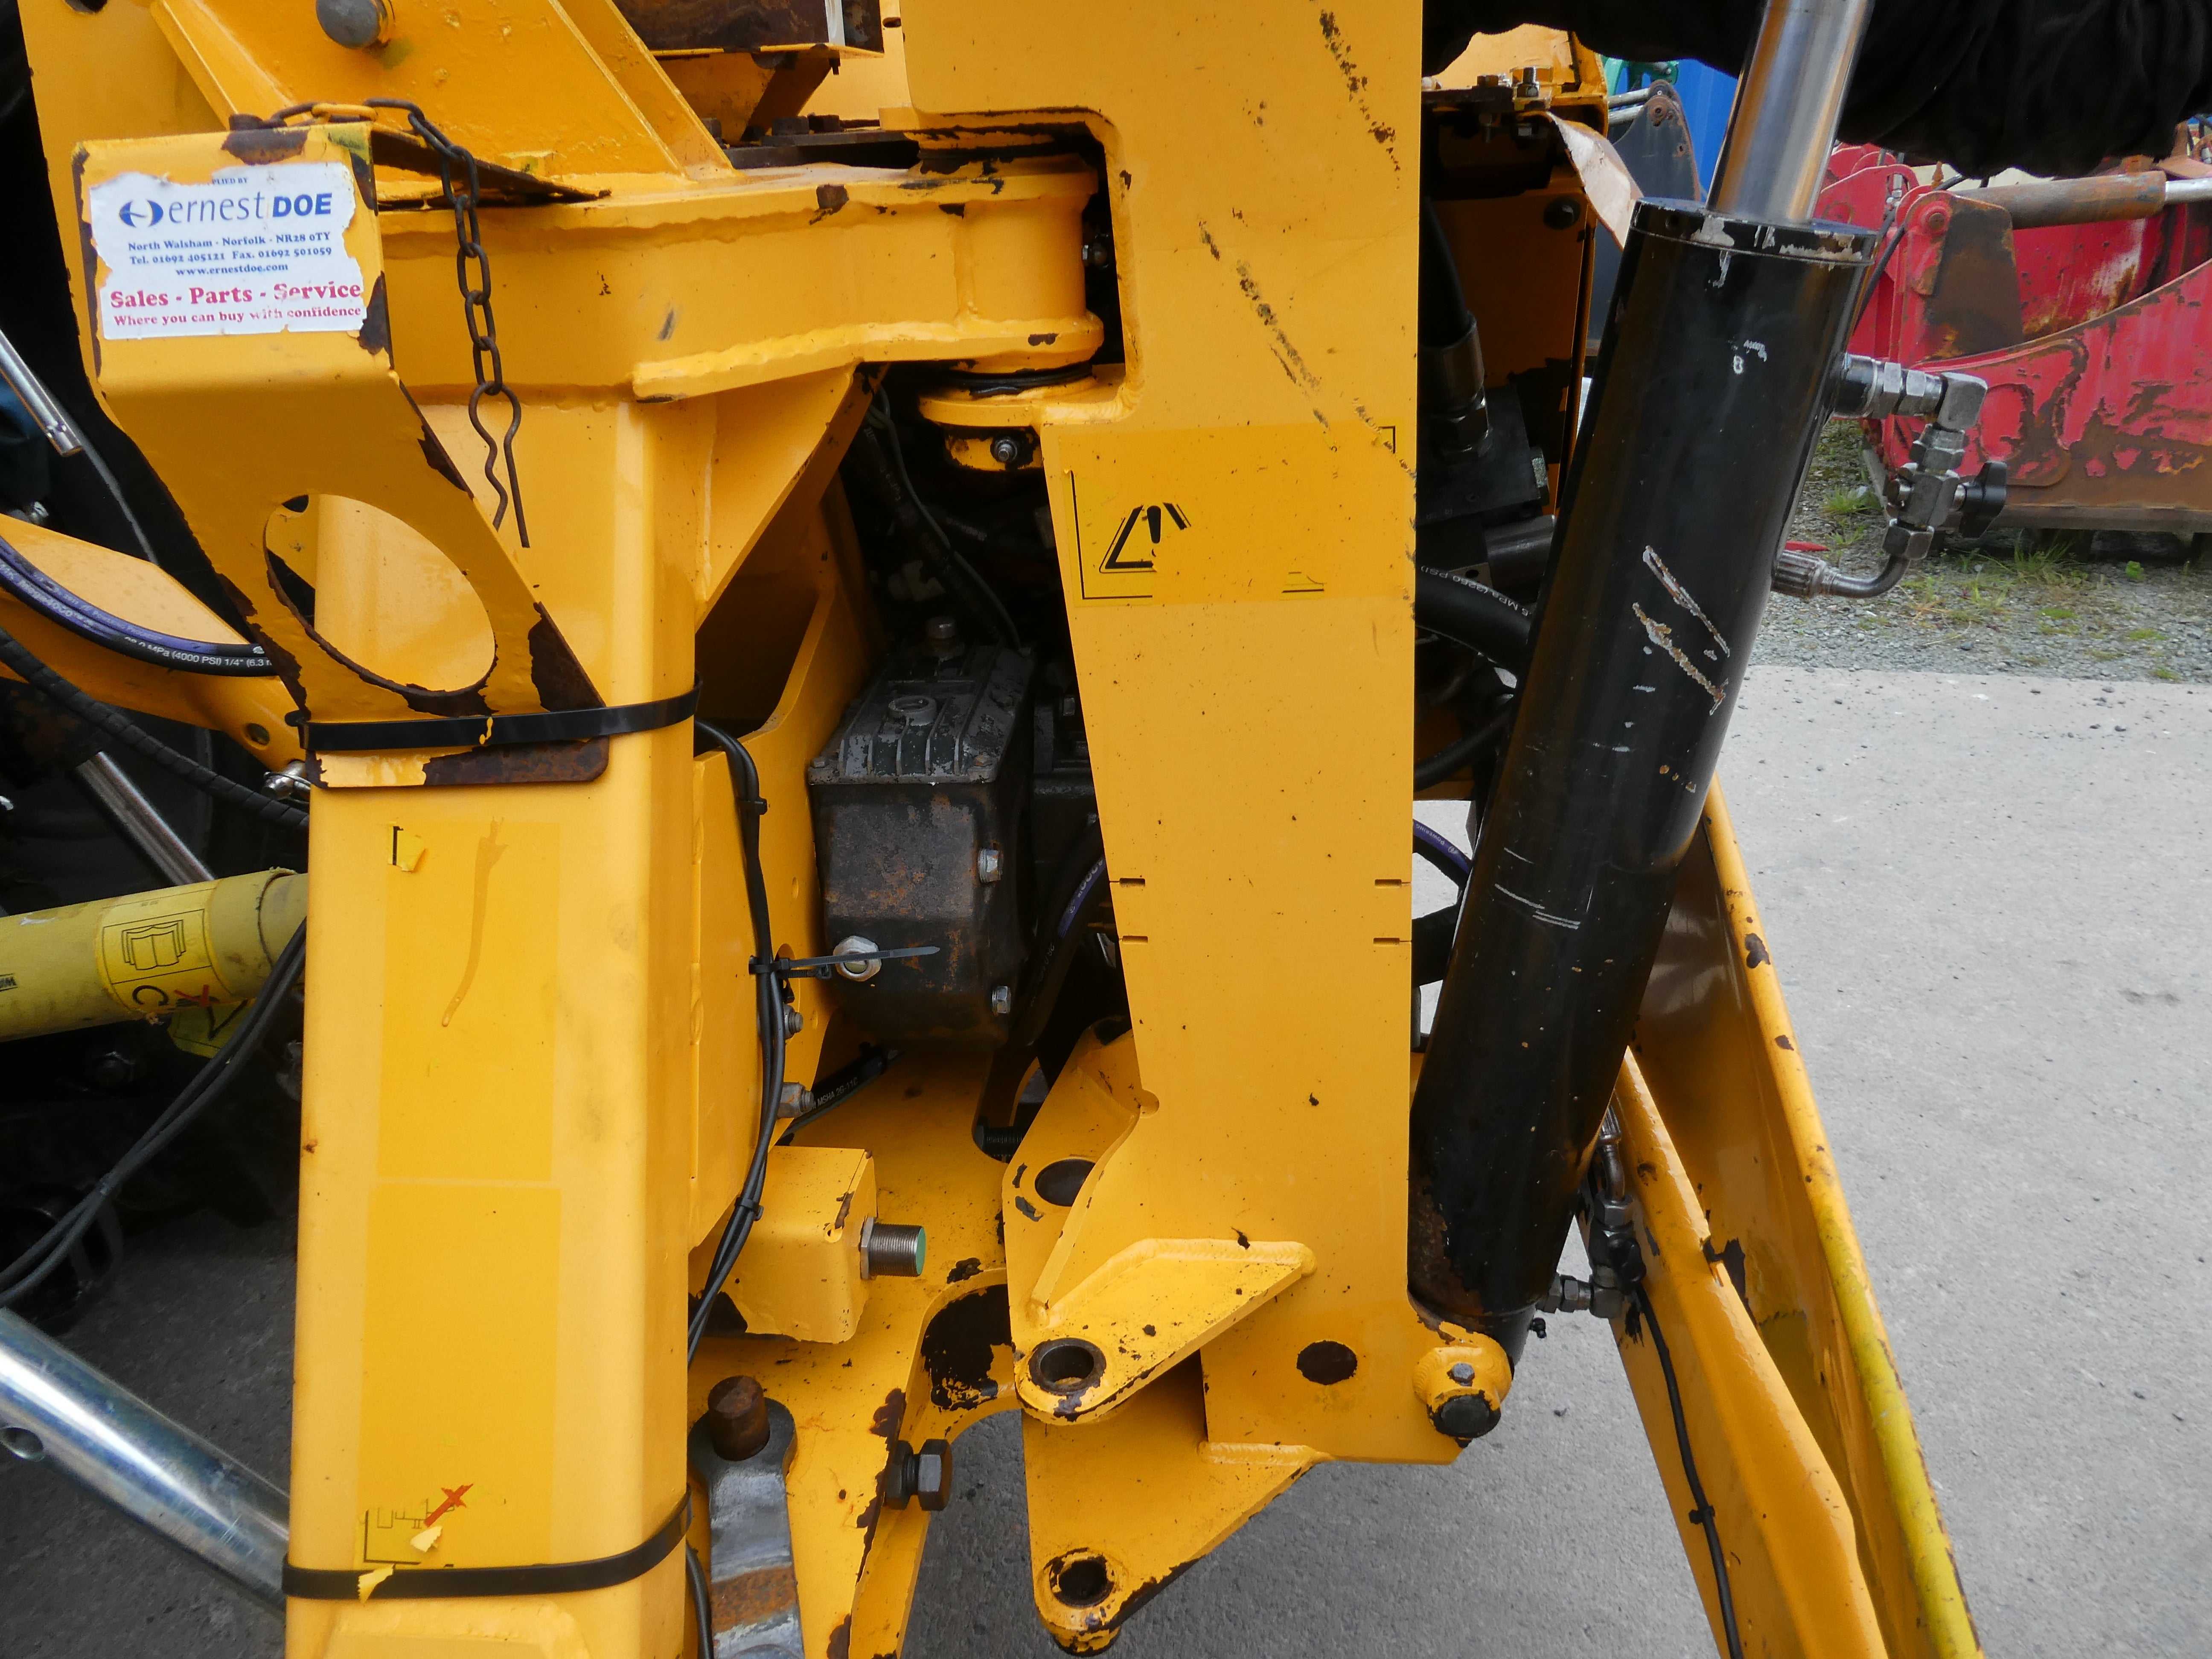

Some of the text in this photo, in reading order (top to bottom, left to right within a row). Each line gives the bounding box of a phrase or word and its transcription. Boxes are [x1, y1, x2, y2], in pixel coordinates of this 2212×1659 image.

[169, 191, 332, 224] ernest DOE
[128, 242, 160, 251] North
[163, 240, 212, 249] Walsham
[222, 236, 266, 246] Norfolk
[276, 234, 306, 243] NR28
[130, 247, 332, 265] Tel. 01692 405121 Fax. 01692 501059
[175, 263, 288, 275] www.ernestdoe.com
[111, 290, 169, 308] Sales
[189, 286, 253, 304] Parts
[274, 281, 361, 300] Service
[114, 306, 361, 326] Where you can buy with confidence
[147, 644, 170, 657] MPa
[172, 651, 200, 662] (4000
[202, 656, 222, 666] PSI)
[246, 658, 264, 668] (6.3
[817, 1091, 835, 1106] MSHA
